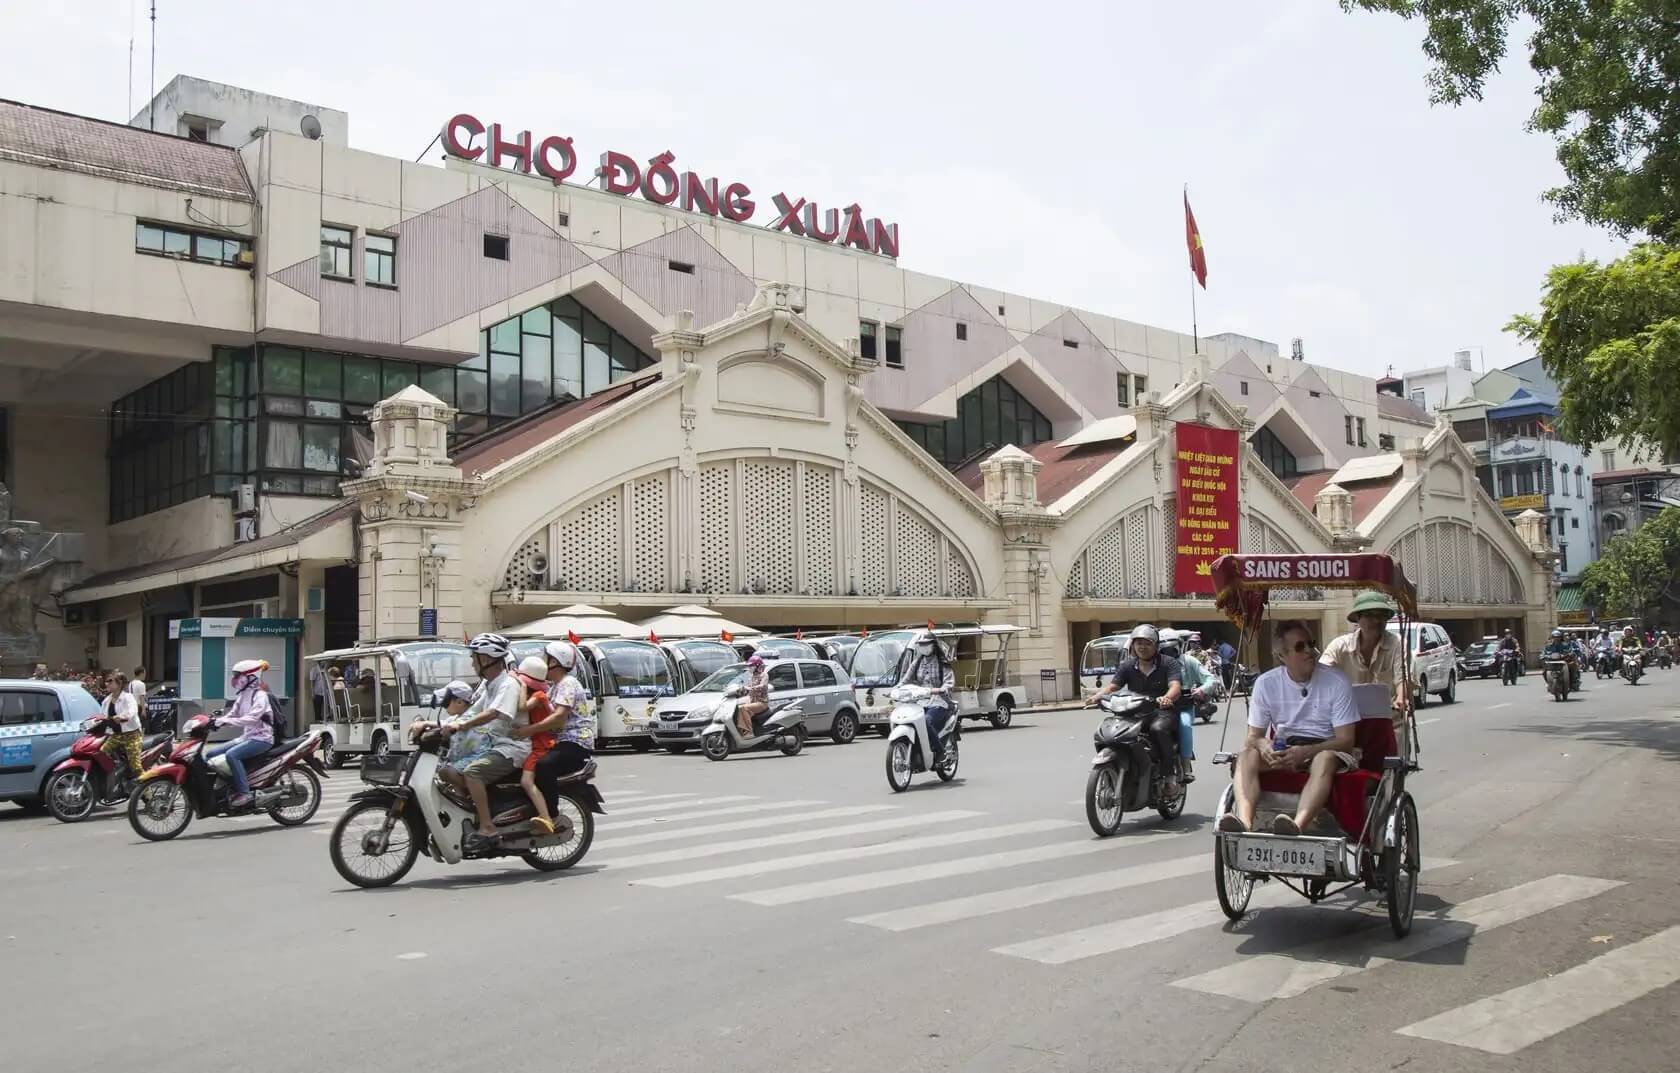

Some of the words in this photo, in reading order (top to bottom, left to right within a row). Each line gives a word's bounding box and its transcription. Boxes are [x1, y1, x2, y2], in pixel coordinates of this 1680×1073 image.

[440, 113, 577, 187] CHỢ
[771, 191, 899, 258] XUÂN
[1244, 560, 1291, 579] SANS
[1296, 559, 1350, 578] SOUCI
